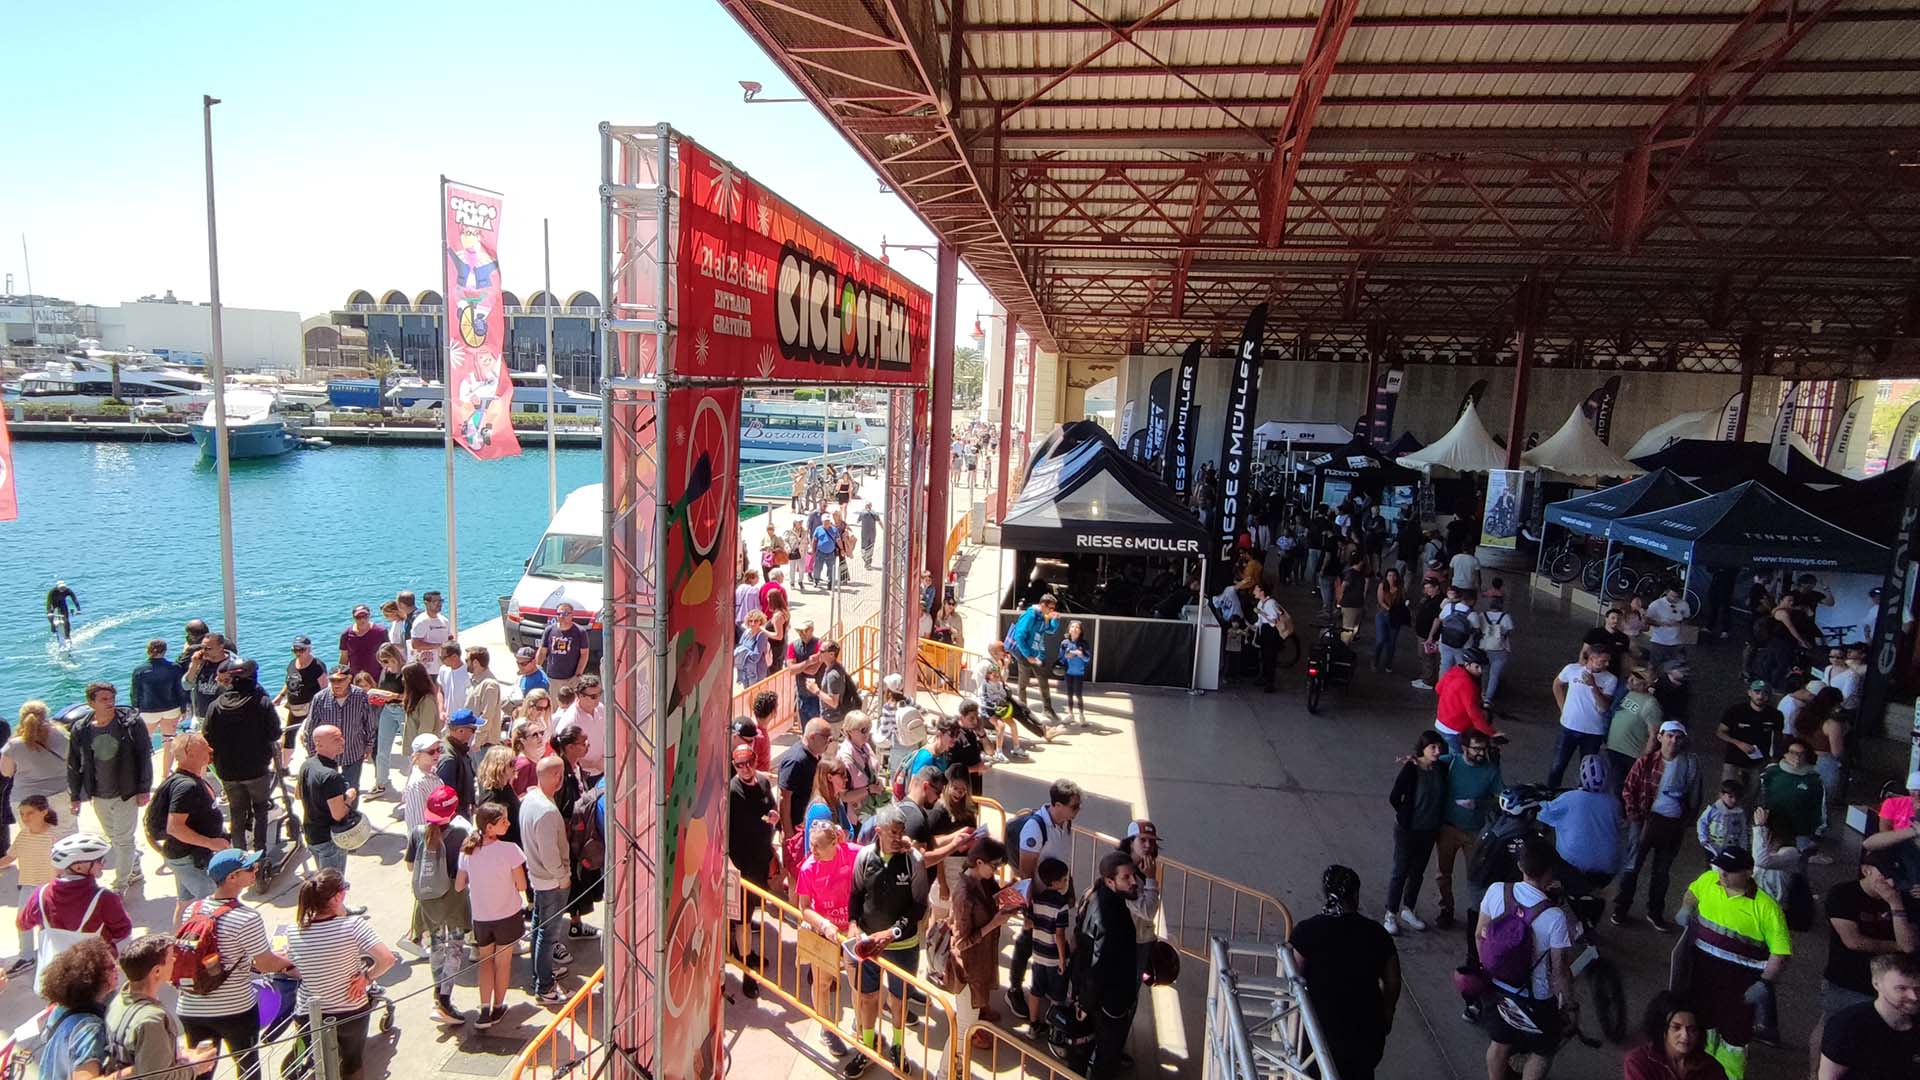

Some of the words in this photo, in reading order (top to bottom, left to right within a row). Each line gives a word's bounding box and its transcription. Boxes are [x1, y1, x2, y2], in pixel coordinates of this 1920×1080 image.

[700, 246, 713, 278] 21
[714, 253, 725, 282] al
[726, 255, 738, 285] 23
[739, 261, 769, 295] d'abril
[714, 288, 752, 315] ENTRADA
[1176, 365, 1193, 441] MÜLLER
[1229, 339, 1255, 455] MÜLLER
[744, 420, 825, 439] Boramar
[1176, 443, 1185, 453] &
[1175, 455, 1186, 497] IESE
[1228, 458, 1240, 475] &
[1221, 478, 1239, 561] RIESE
